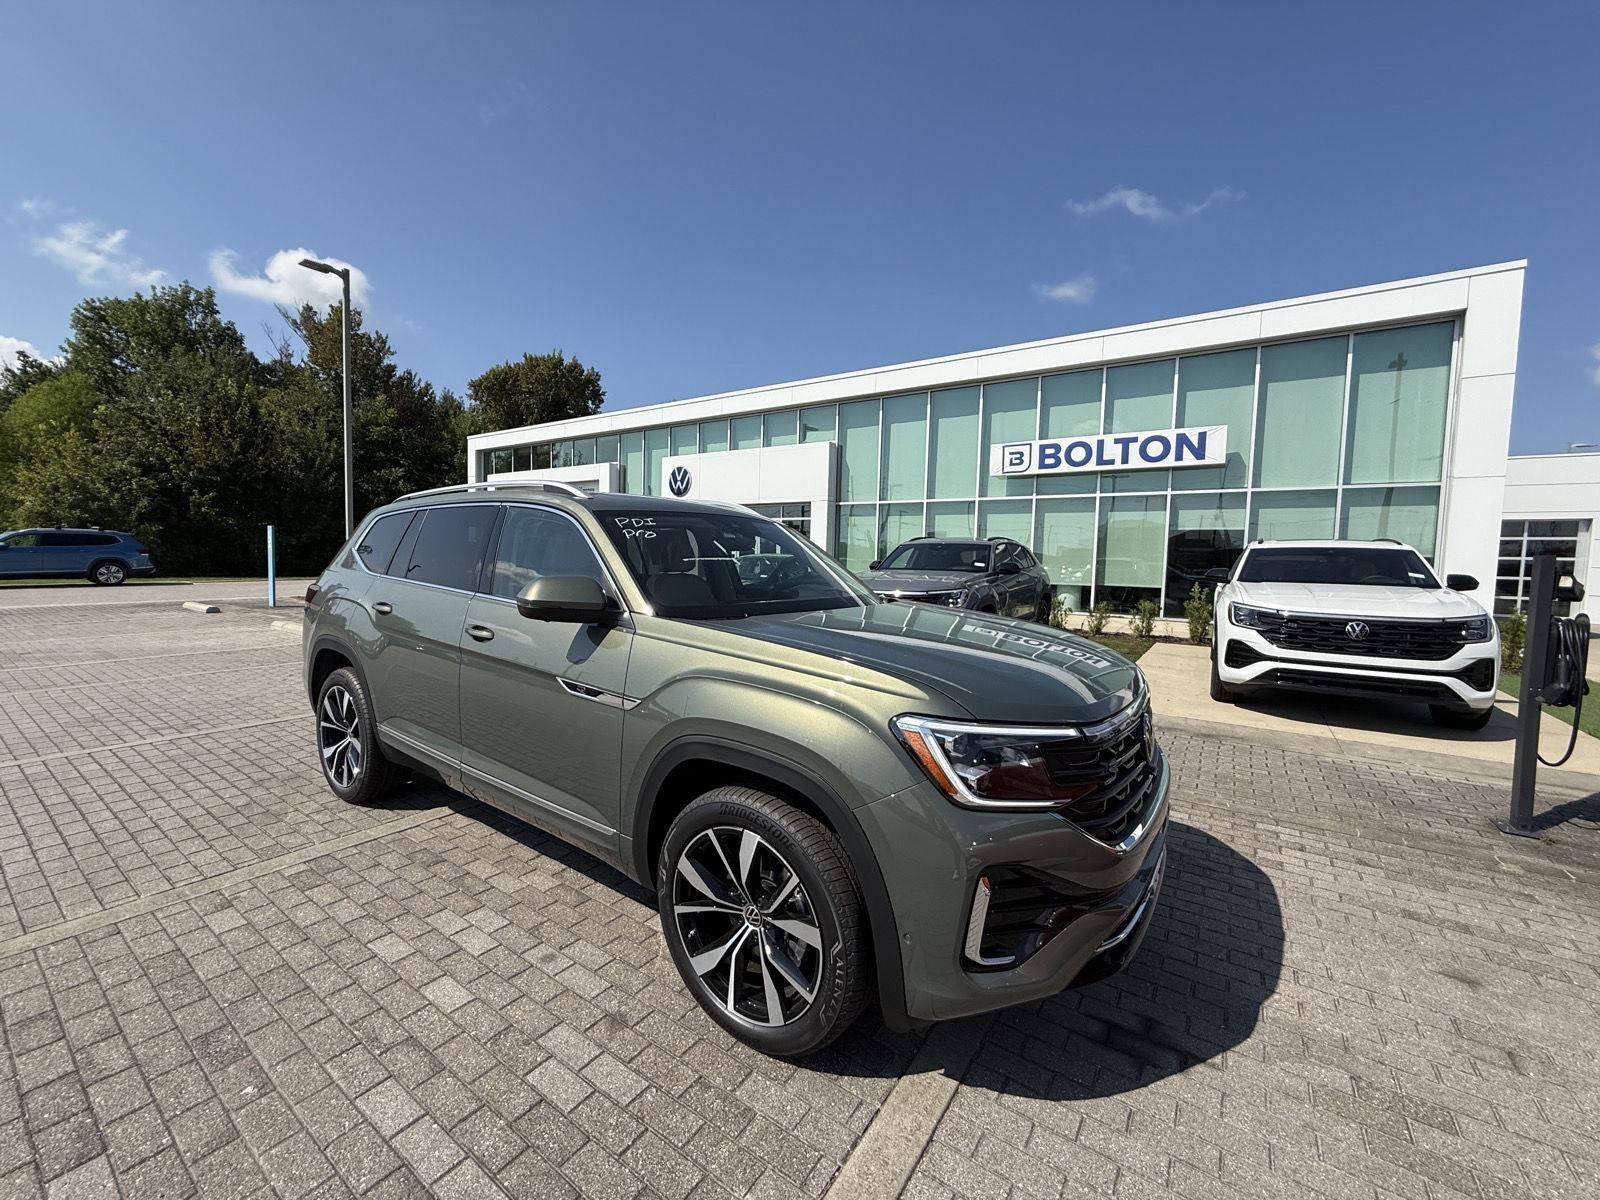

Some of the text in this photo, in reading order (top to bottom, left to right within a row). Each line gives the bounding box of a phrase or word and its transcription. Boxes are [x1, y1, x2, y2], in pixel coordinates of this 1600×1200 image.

[1038, 431, 1207, 470] BOLTON
[669, 467, 692, 497] VW
[615, 517, 656, 528] PDI
